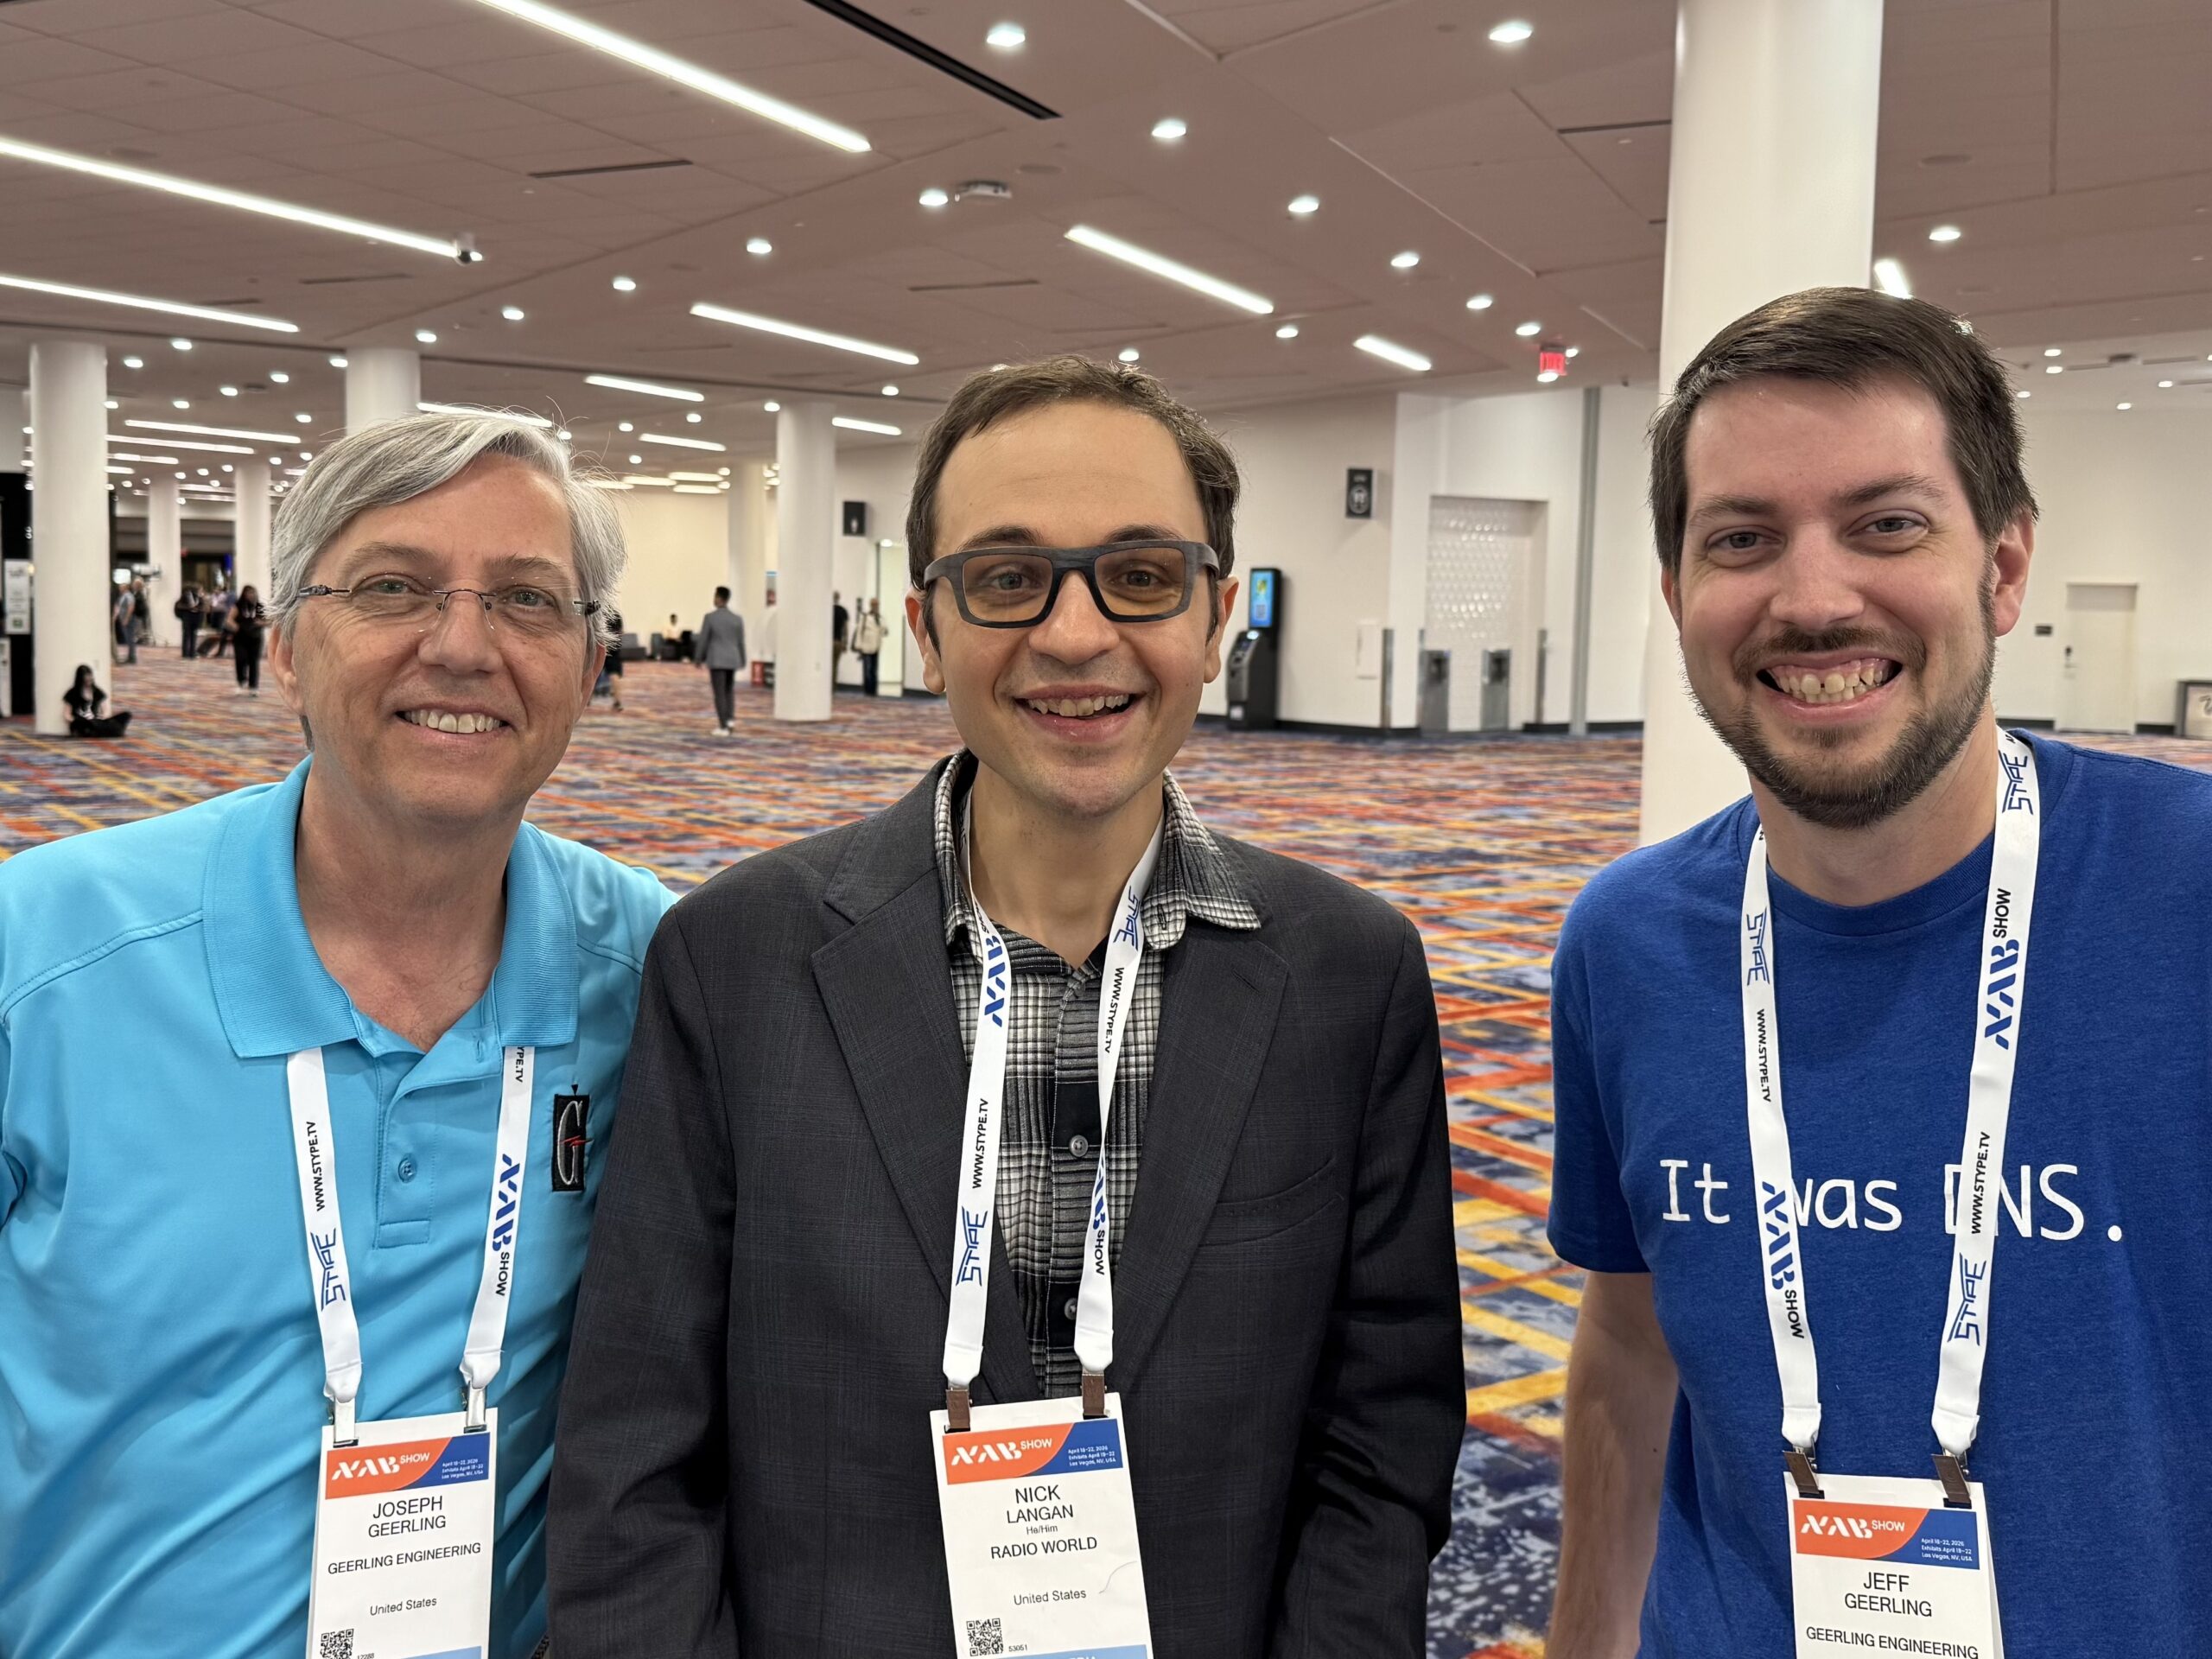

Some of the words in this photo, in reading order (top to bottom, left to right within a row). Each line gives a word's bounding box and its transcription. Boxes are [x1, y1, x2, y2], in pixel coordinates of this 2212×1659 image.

[1993, 888, 2012, 939] SHOW
[1104, 967, 1125, 1053] WWW.STYPE.TV
[1757, 1008, 1771, 1103] WWW.STYPE.TV
[972, 1097, 988, 1189] WWW.STYPE.TV
[306, 1122, 325, 1211] WWW.STYPE.TV
[1660, 1159, 1730, 1224] It
[1971, 1131, 1990, 1234] WWW.STYPE.TV
[1094, 1230, 1105, 1275] SHOW
[495, 1251, 510, 1296] SHOW
[1784, 1289, 1804, 1339] SHOW
[950, 1441, 1021, 1465] NAB
[1020, 1438, 1052, 1452] SHOW
[332, 1456, 400, 1480] NAB
[400, 1452, 430, 1465] SHOW
[372, 1496, 443, 1519] JOSEPH
[1014, 1484, 1061, 1503] NICK
[368, 1515, 446, 1538] GEERLING
[1007, 1504, 1074, 1524] LANGAN
[1801, 1515, 1872, 1539] NAB
[1872, 1519, 1905, 1532] SHOW
[1026, 1524, 1058, 1535] He/Him
[328, 1555, 393, 1574] GEERLING
[396, 1542, 481, 1565] ENGINEERING
[991, 1542, 1038, 1560] RADIO
[1040, 1536, 1097, 1554] WORLD
[1863, 1572, 1910, 1592] JEFF
[370, 1601, 403, 1616] United
[405, 1598, 437, 1611] States
[1014, 1591, 1049, 1605] United
[1052, 1589, 1086, 1602] States
[1844, 1593, 1932, 1617] GEERLING
[1806, 1626, 1875, 1647] GEERLING
[1878, 1635, 1979, 1659] ENGINEERING
